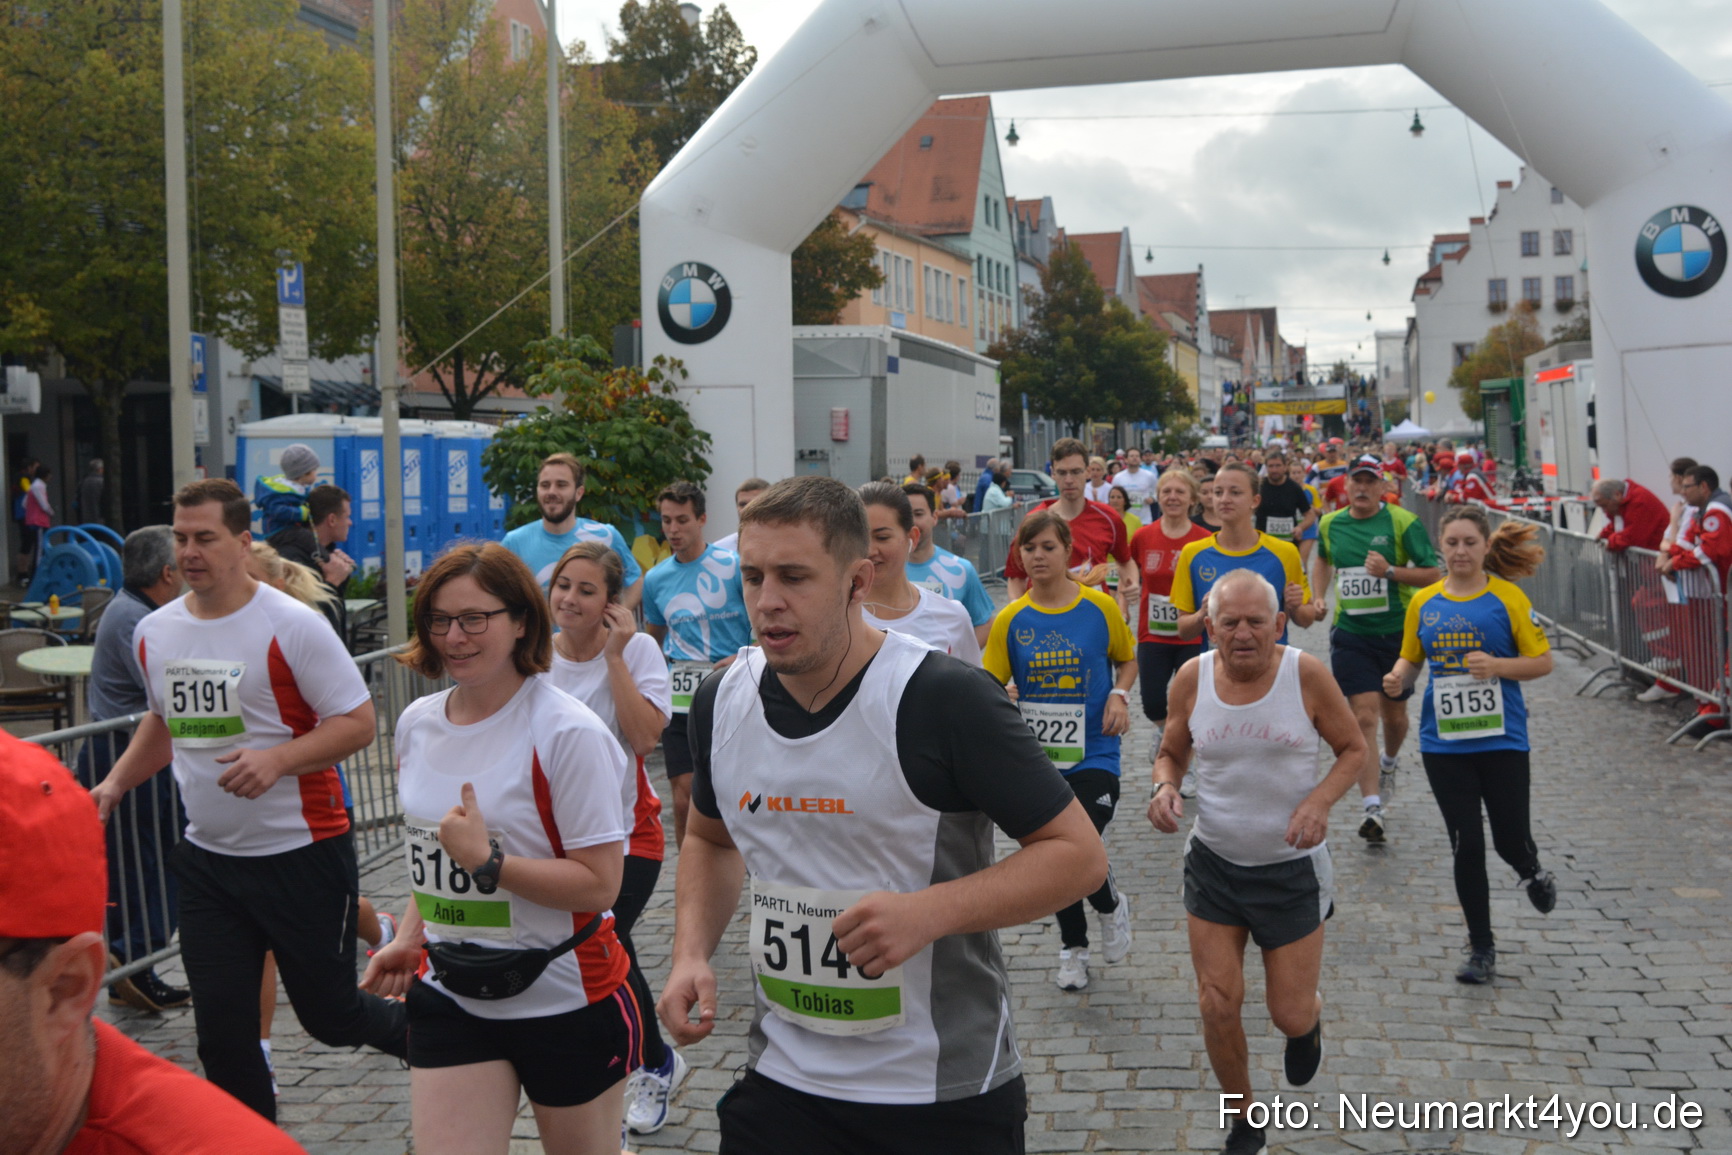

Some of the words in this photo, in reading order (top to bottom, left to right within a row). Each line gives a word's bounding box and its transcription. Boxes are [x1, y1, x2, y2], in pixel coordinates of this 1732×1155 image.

[1642, 207, 1720, 240] BMW
[662, 263, 725, 291] BMW
[1342, 578, 1382, 597] 5504
[173, 680, 228, 713] 5191
[1441, 688, 1496, 716] 5153
[1040, 710, 1073, 718] Neumarkt
[180, 722, 227, 738] Benjamin
[767, 796, 854, 814] KLEBL
[405, 826, 429, 841] ARTL
[434, 902, 465, 925] Anja
[754, 894, 794, 914] PARTL
[763, 918, 885, 981] 514
[791, 988, 854, 1016] Tobias
